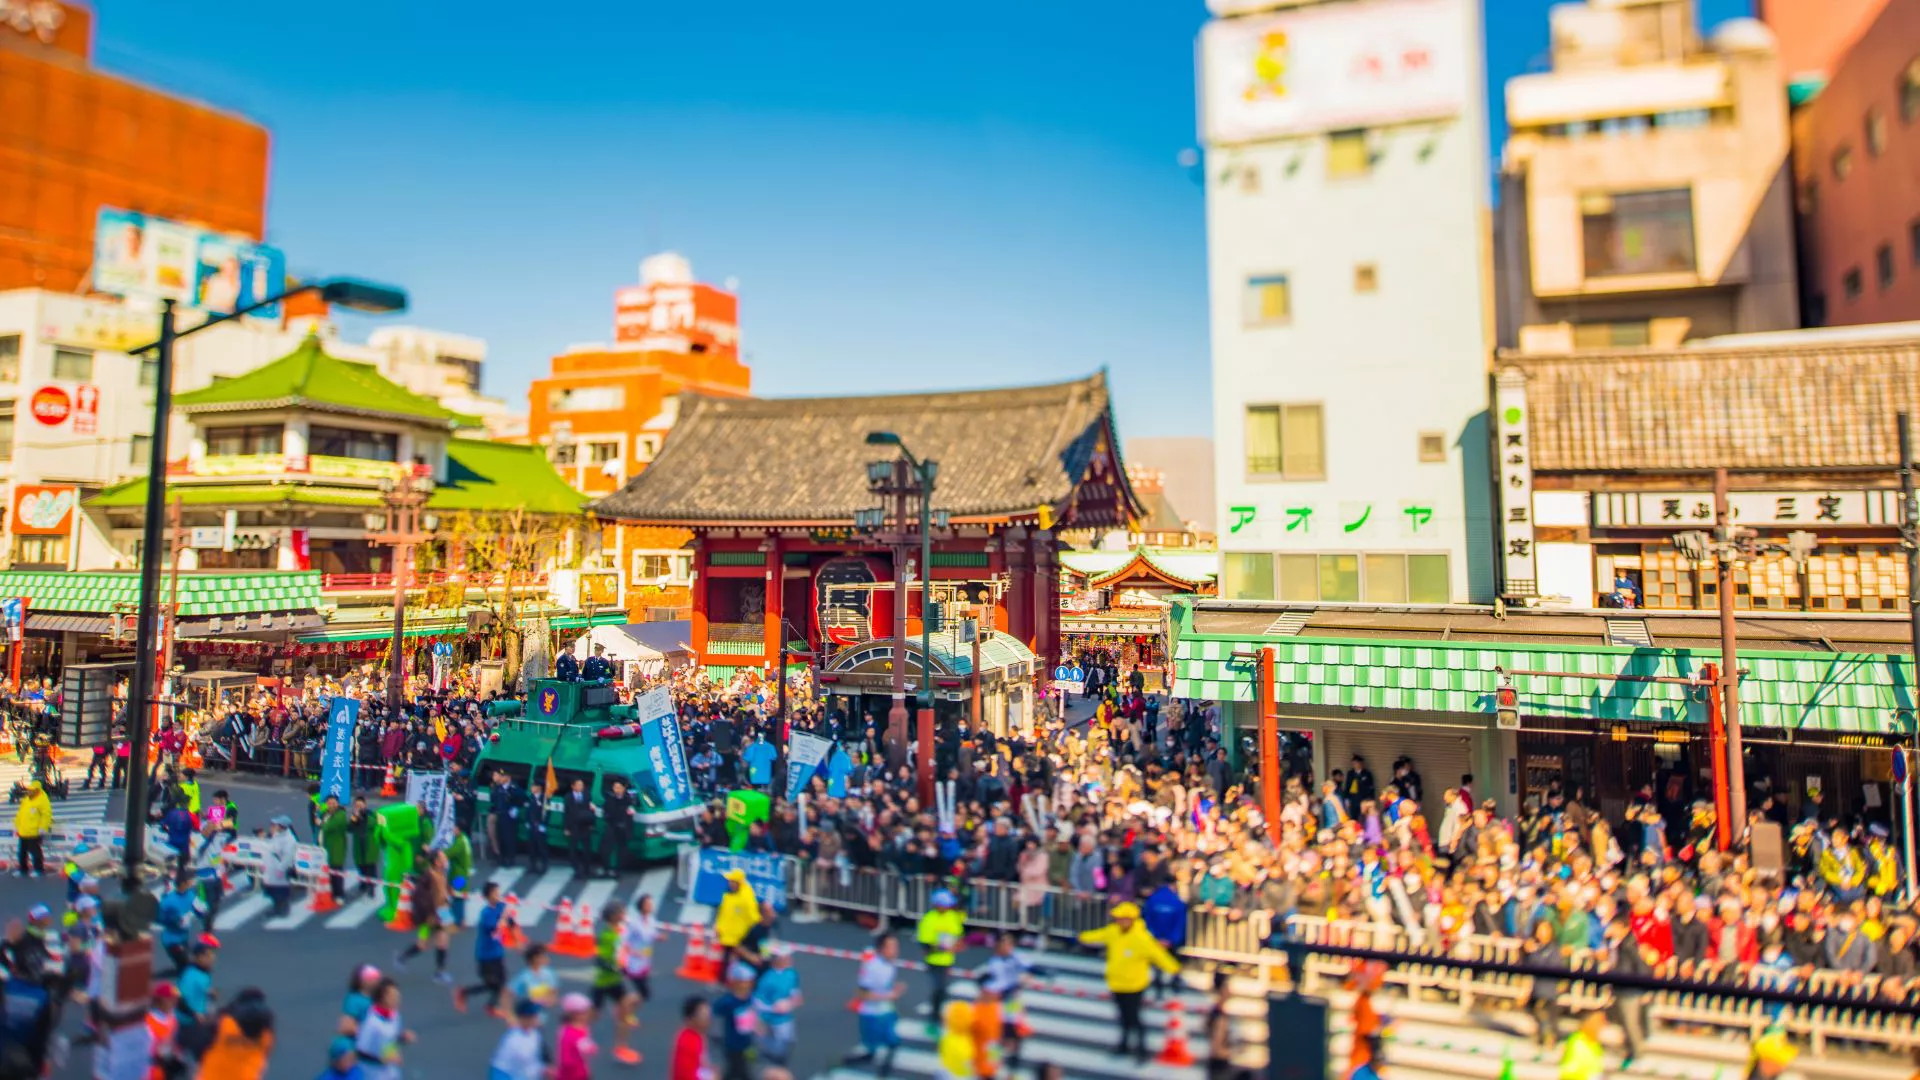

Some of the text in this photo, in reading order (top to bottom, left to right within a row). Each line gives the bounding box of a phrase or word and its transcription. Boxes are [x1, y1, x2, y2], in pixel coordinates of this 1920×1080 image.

[1506, 434, 1530, 557] 天ぷら 三定
[1662, 490, 1842, 521] 天ぷ 三定
[1230, 504, 1433, 534] アオノヤ
